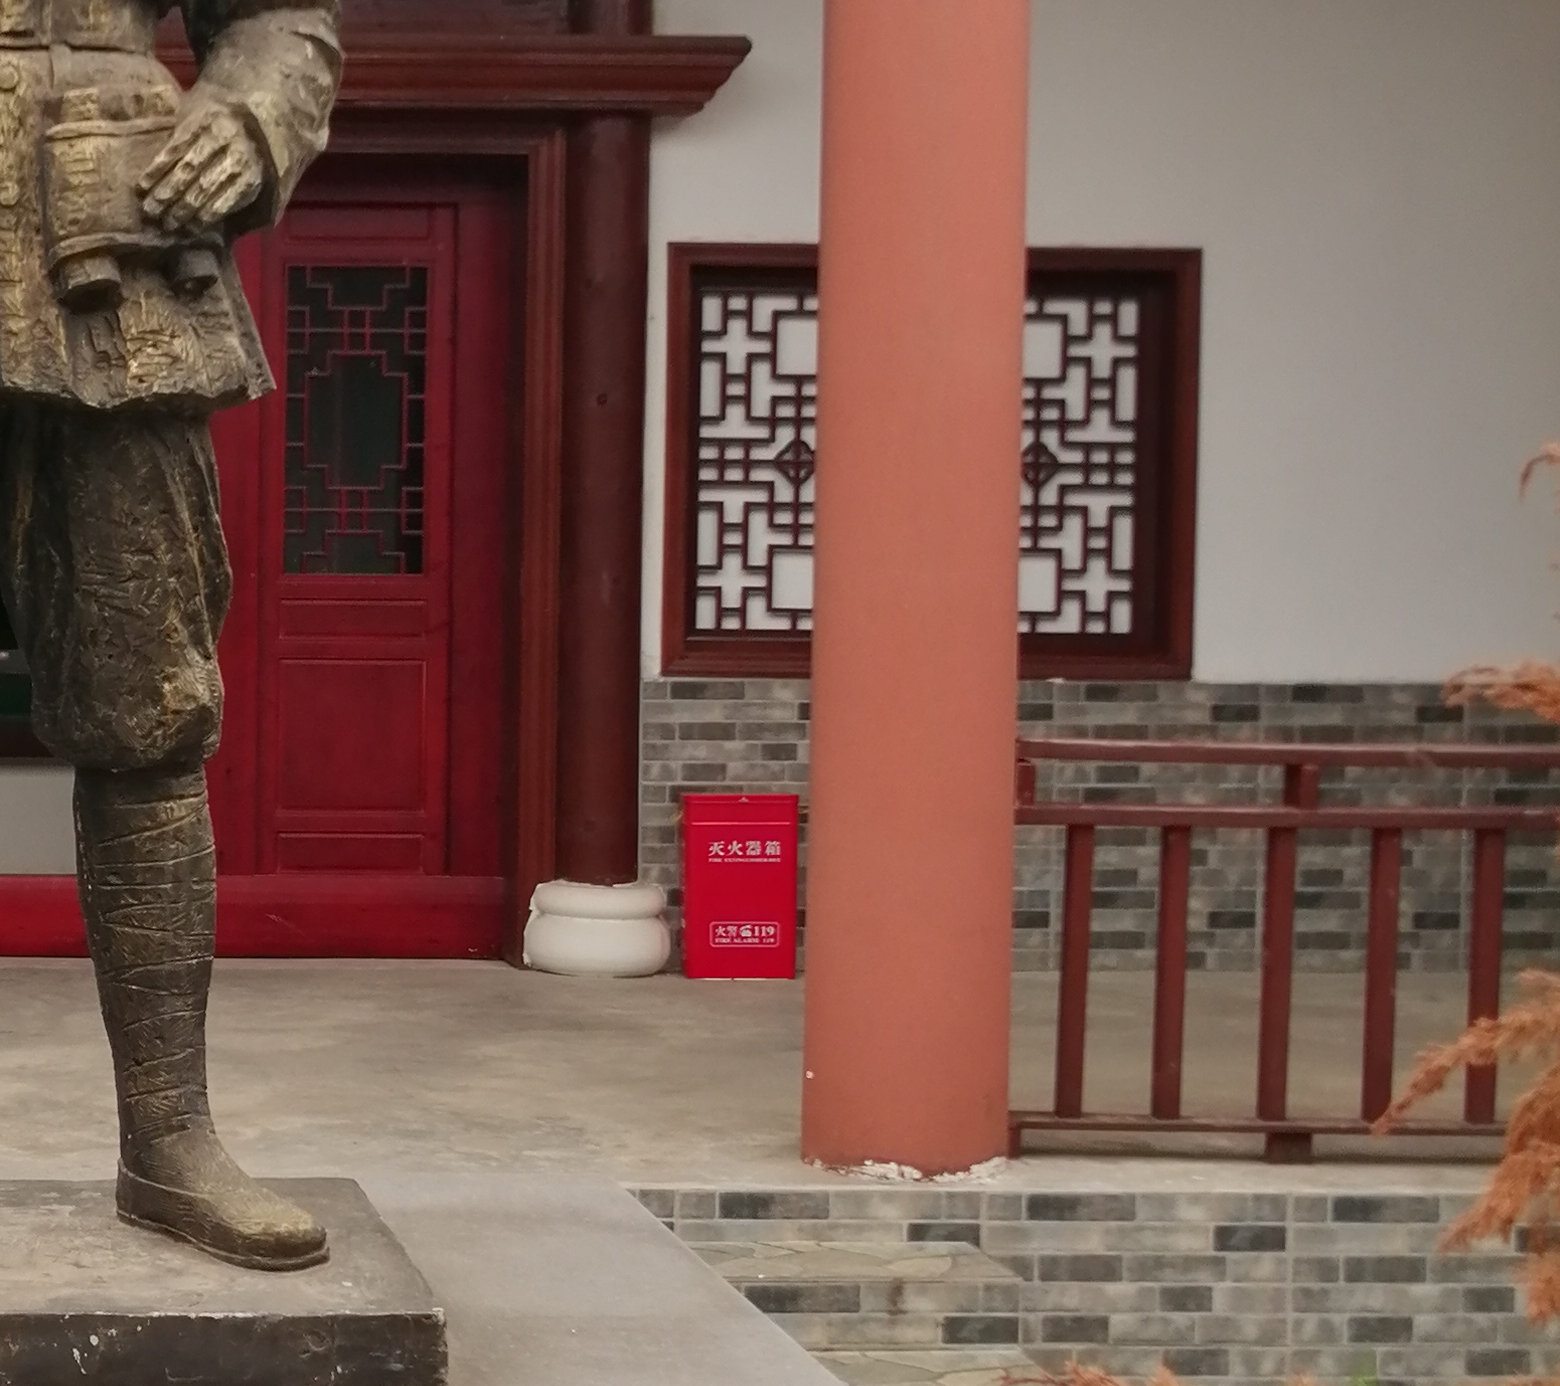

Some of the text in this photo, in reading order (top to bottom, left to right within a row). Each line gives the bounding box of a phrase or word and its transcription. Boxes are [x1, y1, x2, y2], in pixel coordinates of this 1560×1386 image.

[708, 840, 782, 856] 灭火器箱
[754, 925, 775, 937] 119
